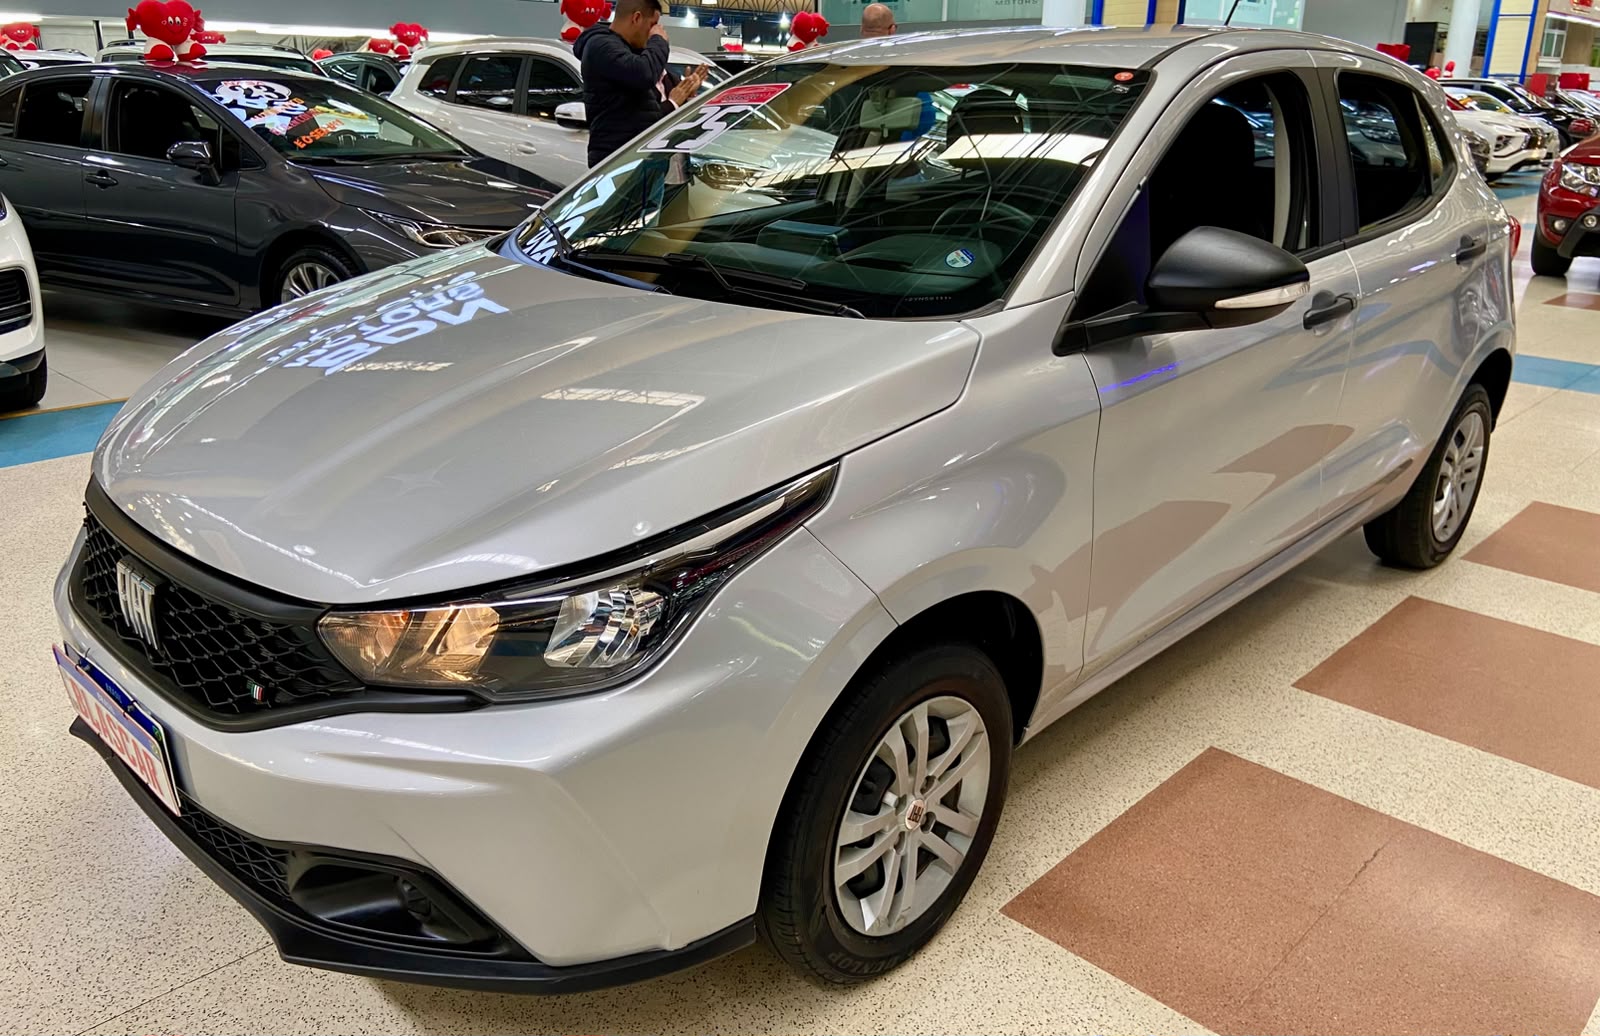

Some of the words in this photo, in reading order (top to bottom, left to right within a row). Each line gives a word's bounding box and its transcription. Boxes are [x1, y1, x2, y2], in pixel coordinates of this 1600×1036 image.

[647, 105, 752, 149] 25
[116, 561, 158, 651] FIAT
[69, 678, 165, 798] BLASCAR
